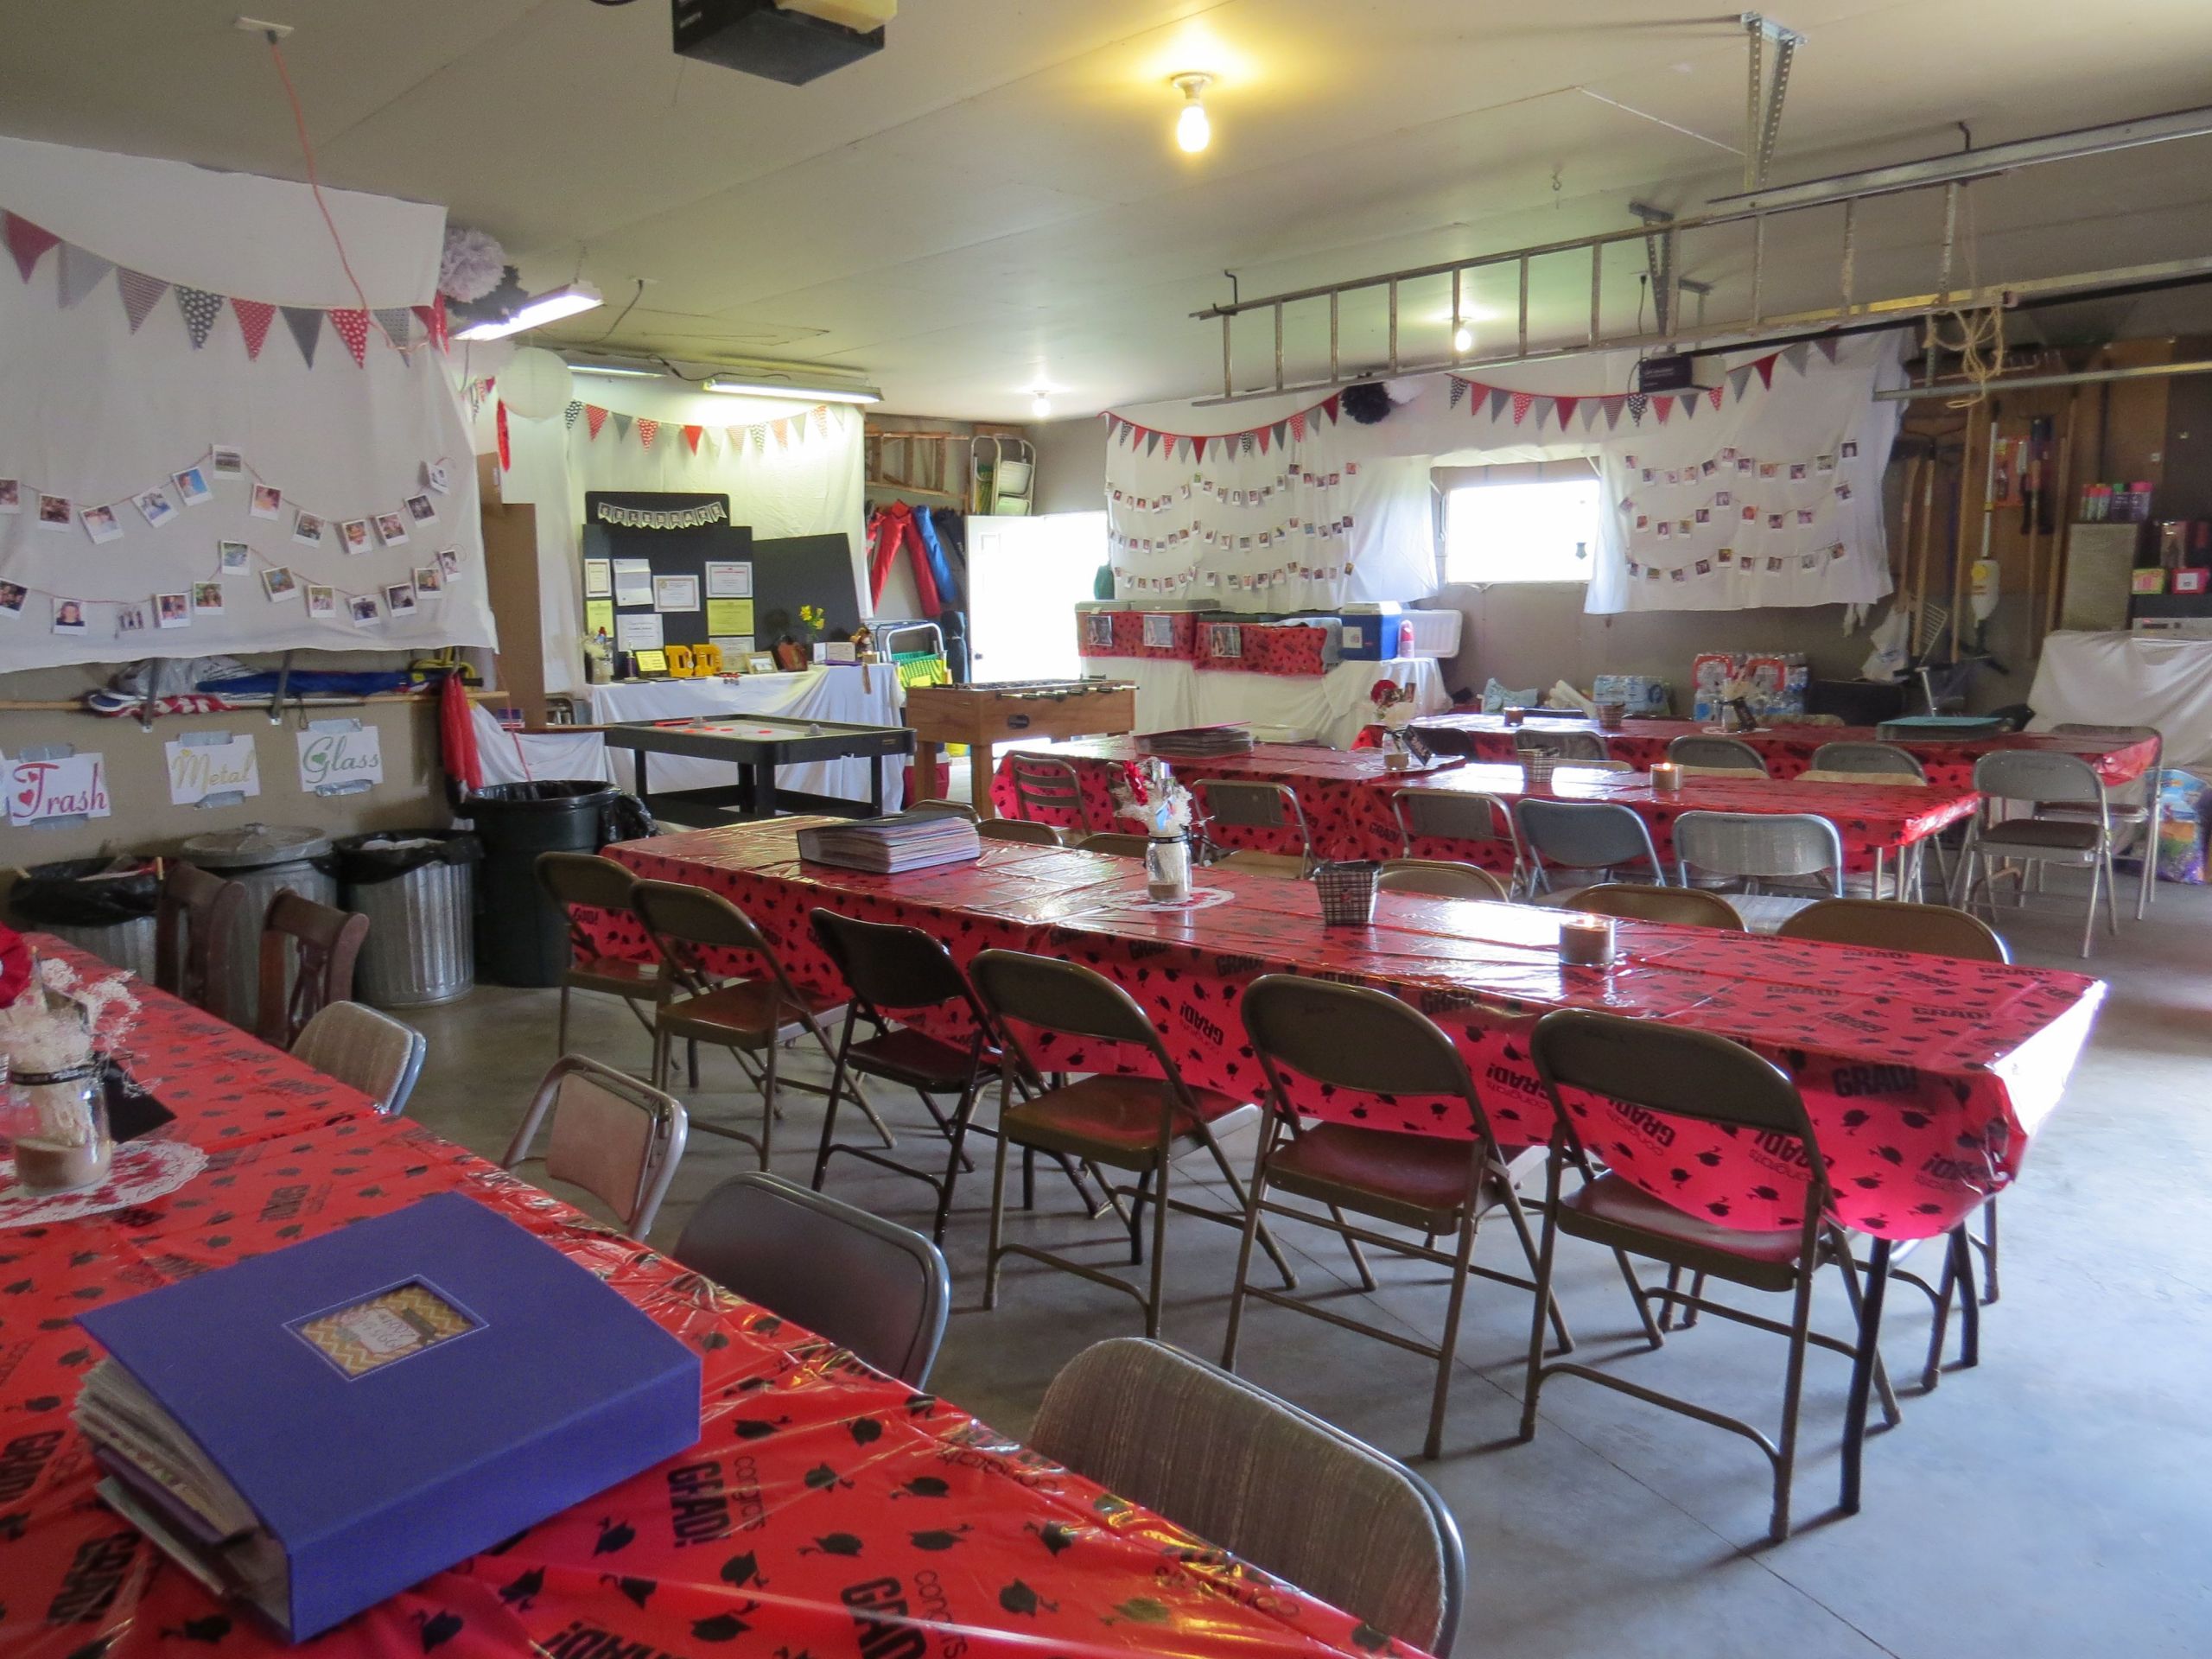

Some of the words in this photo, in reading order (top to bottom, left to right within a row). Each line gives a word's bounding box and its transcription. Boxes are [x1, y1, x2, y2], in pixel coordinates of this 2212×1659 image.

[172, 748, 253, 792] Metal
[303, 735, 379, 784] Glass
[13, 762, 107, 817] Trash
[1833, 1065, 1917, 1097] GRAD!
[667, 1460, 731, 1548] GRAD!
